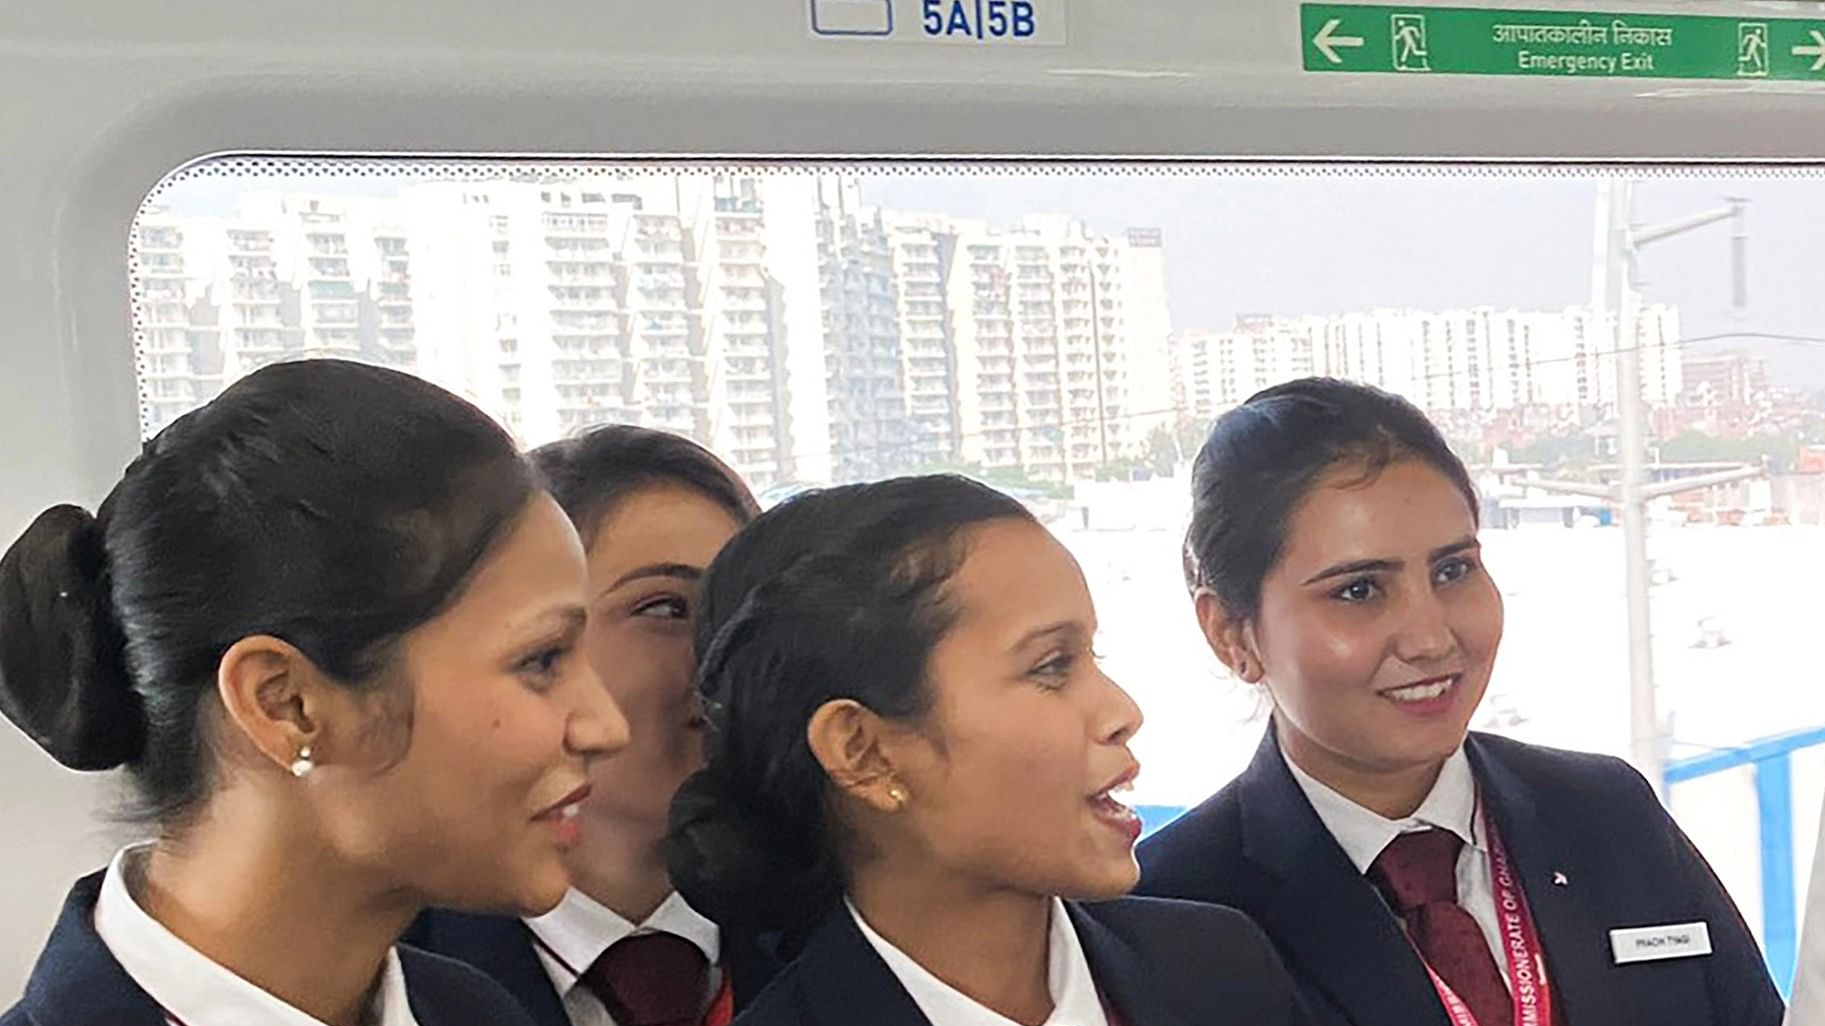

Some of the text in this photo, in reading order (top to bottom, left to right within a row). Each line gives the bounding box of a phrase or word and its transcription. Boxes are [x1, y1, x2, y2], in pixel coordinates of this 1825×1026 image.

[1493, 19, 1673, 46] आपातकालीन निकास
[1518, 51, 1654, 73] Emergency Exit
